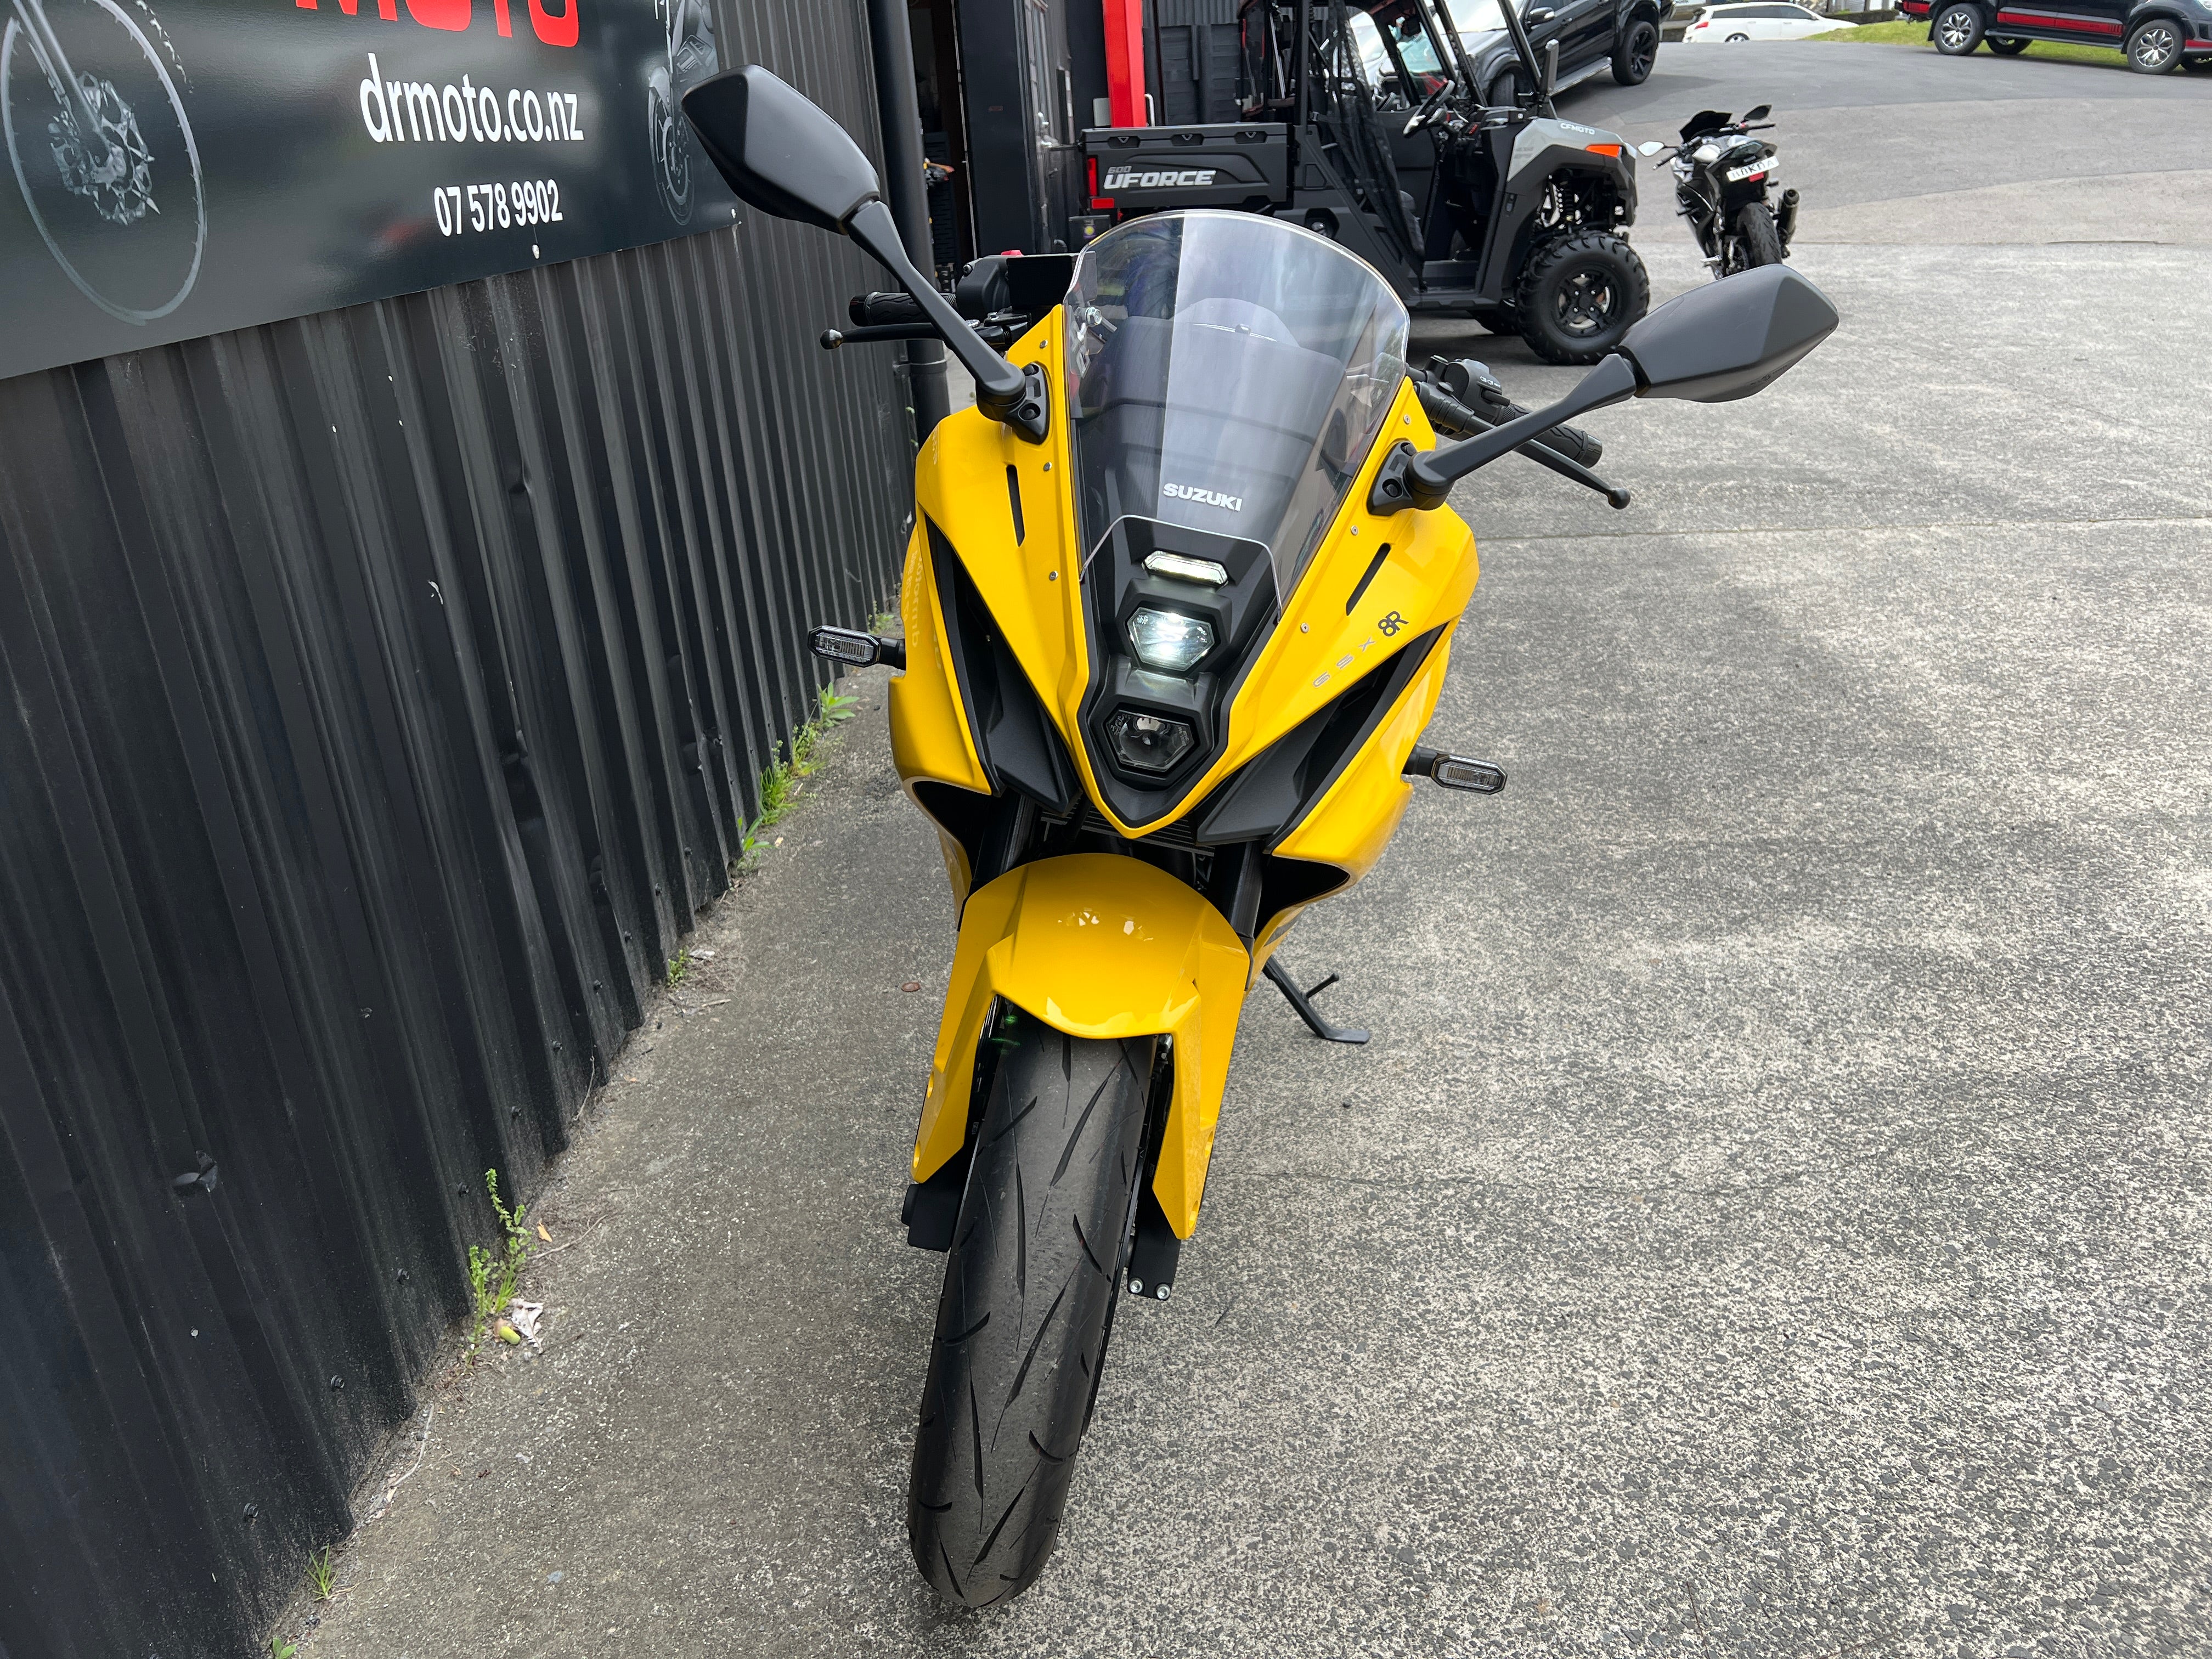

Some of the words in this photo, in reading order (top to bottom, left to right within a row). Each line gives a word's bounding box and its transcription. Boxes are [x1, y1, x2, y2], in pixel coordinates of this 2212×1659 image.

[360, 52, 584, 143] drmoto.co.nz
[1560, 122, 1595, 135] CFMOTO
[1103, 170, 1216, 189] UFORCE
[1107, 166, 1132, 174] 600
[434, 187, 462, 236] 07
[467, 183, 511, 233] 578
[511, 179, 563, 226] 9902
[1163, 483, 1243, 512] SUZUKI
[1378, 611, 1409, 637] 8R
